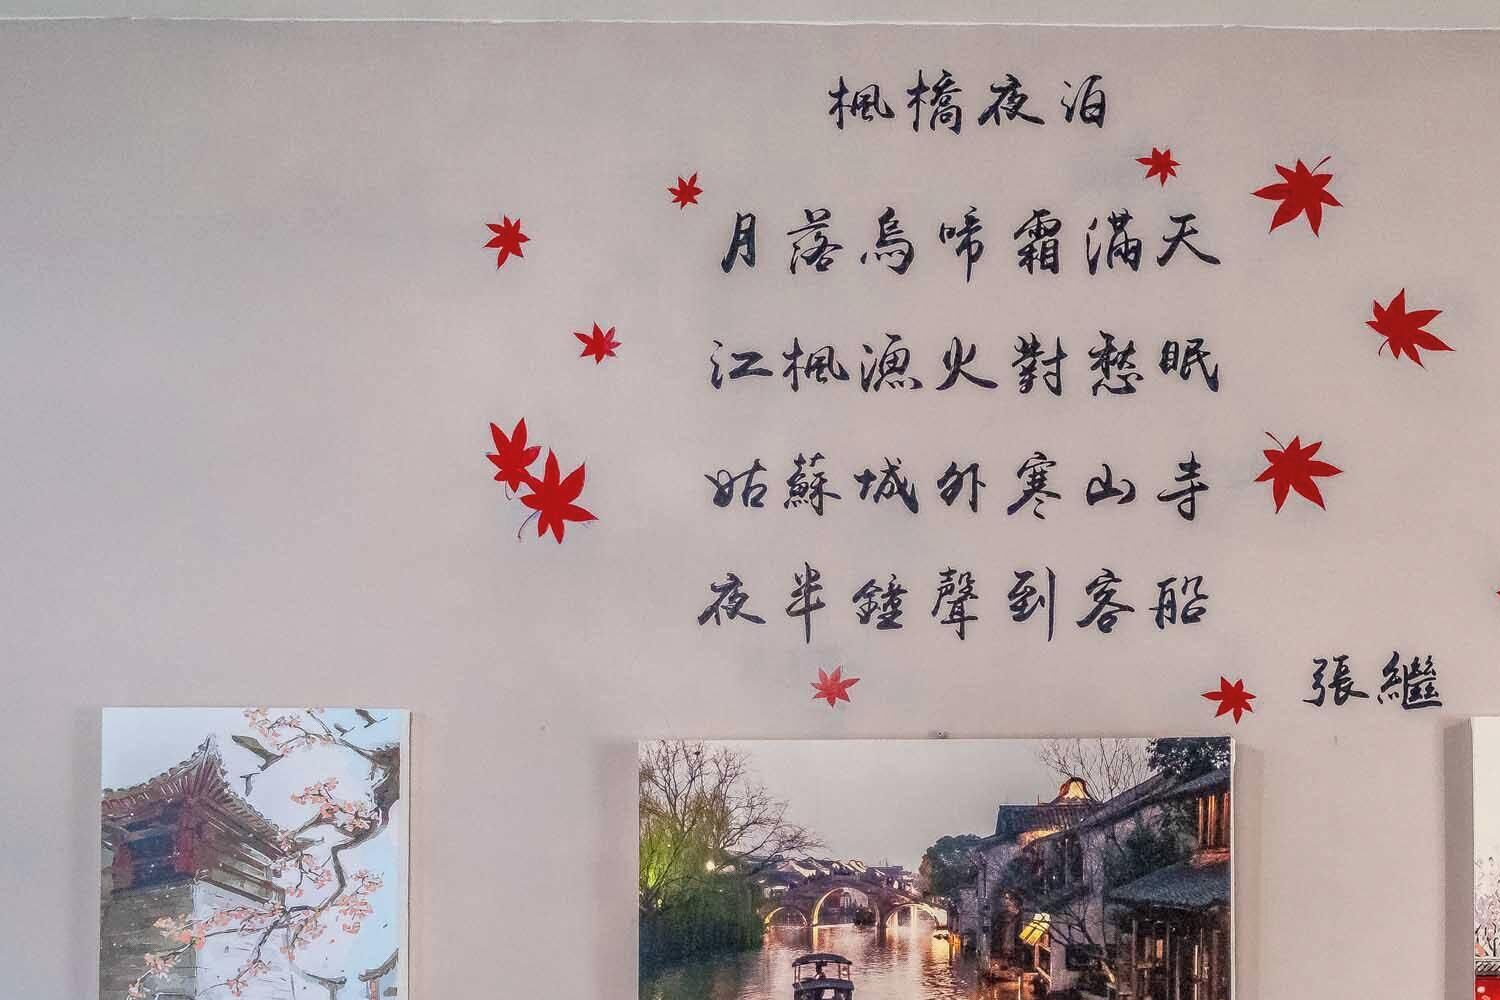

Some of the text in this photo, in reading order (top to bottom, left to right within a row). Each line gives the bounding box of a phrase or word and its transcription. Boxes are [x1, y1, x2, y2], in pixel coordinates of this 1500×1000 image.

[828, 69, 1108, 137] 楓橋夜泊
[710, 329, 1221, 397] 江楓漁火對愁眠
[705, 451, 1211, 522] 姑蘇城外寒山寺
[1304, 651, 1444, 713] 張繼
